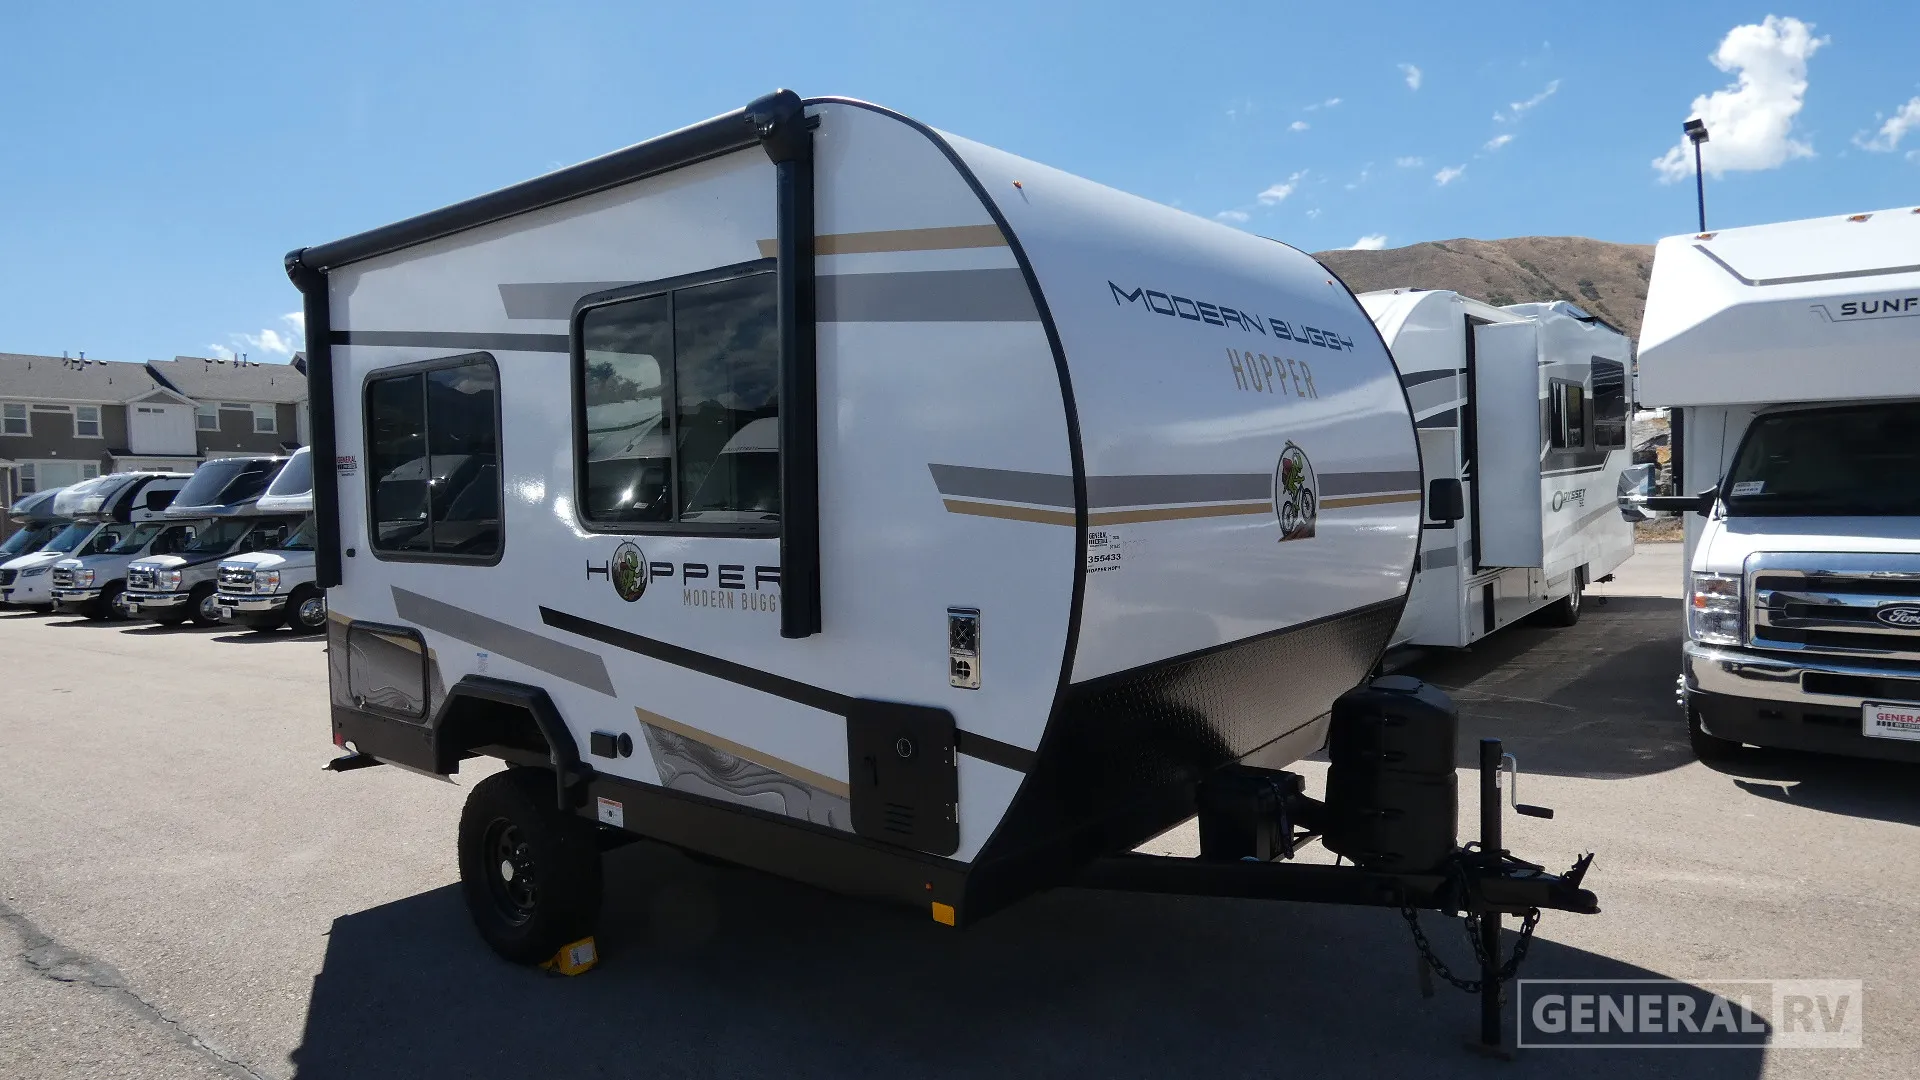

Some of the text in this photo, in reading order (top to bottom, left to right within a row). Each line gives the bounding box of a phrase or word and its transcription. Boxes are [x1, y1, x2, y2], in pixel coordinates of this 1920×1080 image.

[1107, 279, 1354, 353] MODERN BUGGY
[1841, 297, 1919, 316] SUNF
[1226, 347, 1319, 400] HOPPER
[1552, 488, 1586, 512] ODYSSEY
[1088, 553, 1121, 563] 355433
[683, 588, 781, 613] MODERN BUGG
